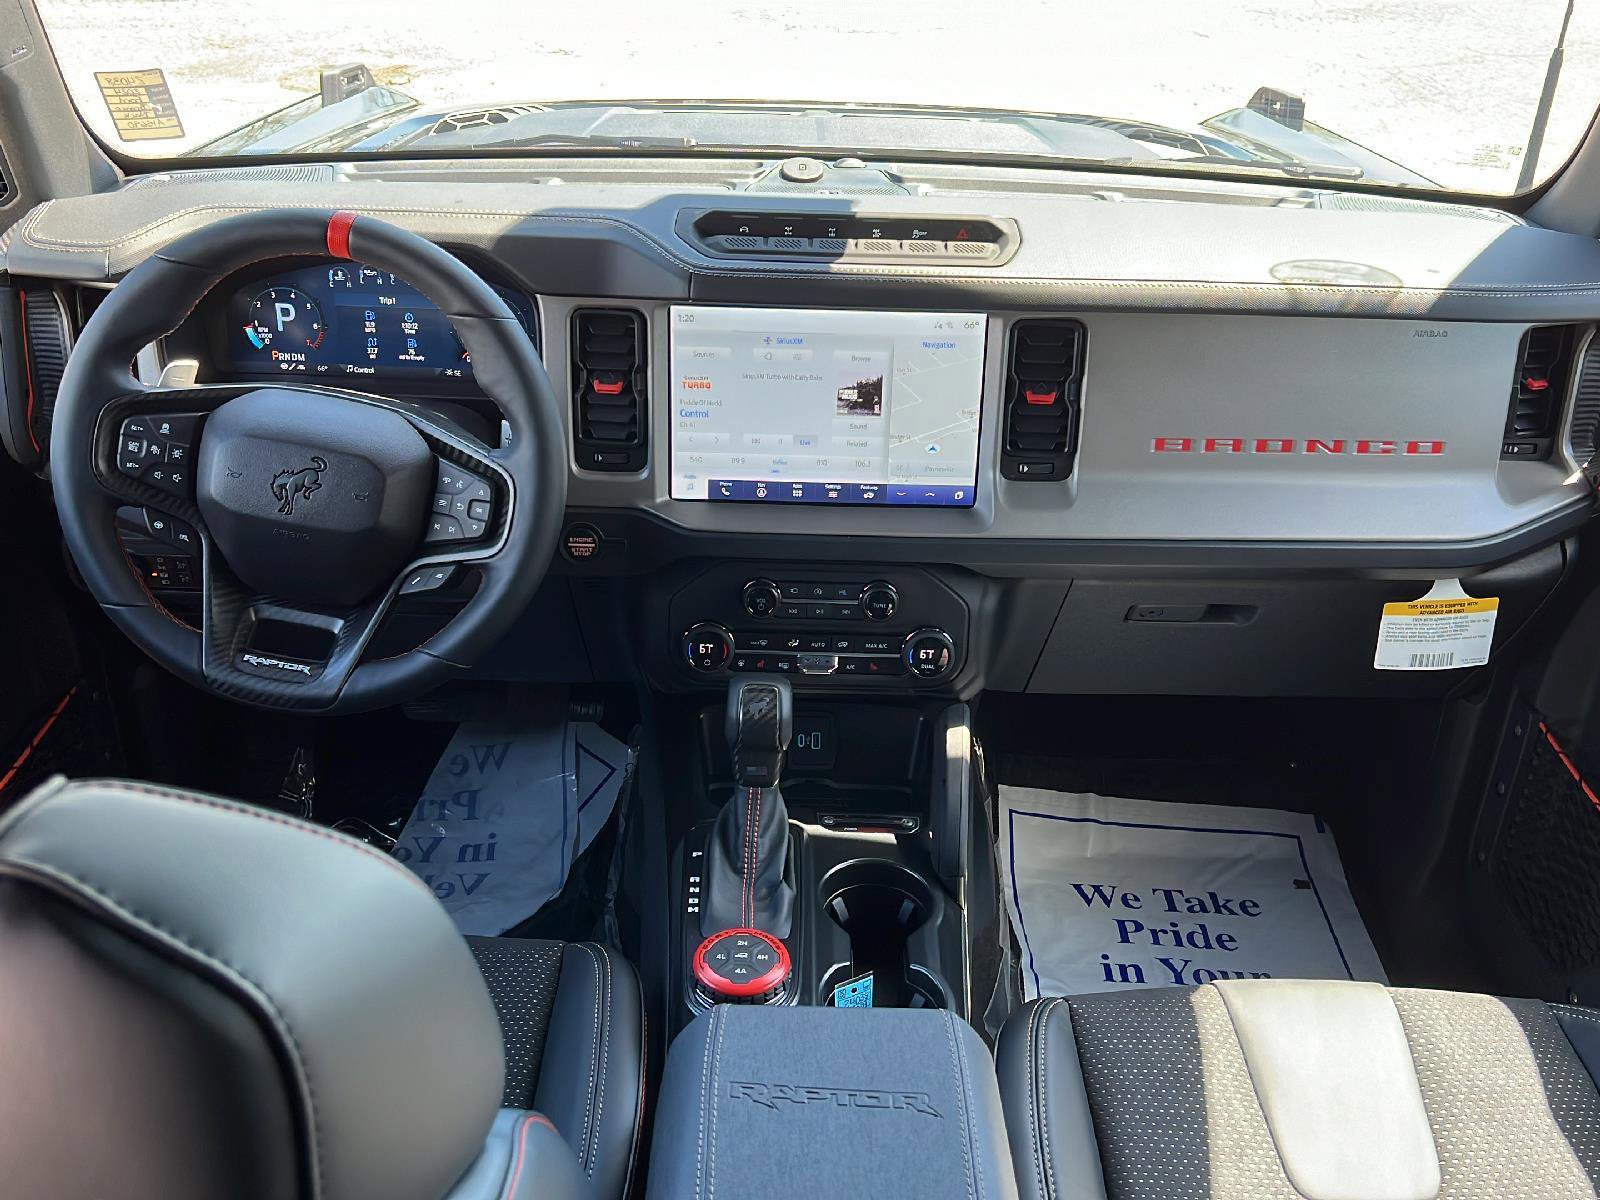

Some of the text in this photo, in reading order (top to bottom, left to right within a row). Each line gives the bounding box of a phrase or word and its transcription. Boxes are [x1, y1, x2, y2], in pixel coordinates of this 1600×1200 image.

[275, 303, 296, 332] P
[678, 314, 694, 322] 1:20
[1412, 330, 1448, 338] AIRBAG
[922, 341, 956, 349] Navigation
[354, 366, 375, 374] Control
[682, 381, 712, 390] TURBO
[680, 409, 709, 418] Control
[1150, 438, 1448, 456] BRONCO
[1069, 883, 1262, 917] We Take
[1112, 918, 1239, 952] Pride
[1100, 954, 1148, 984] in
[730, 1081, 944, 1119] RAPTOR
